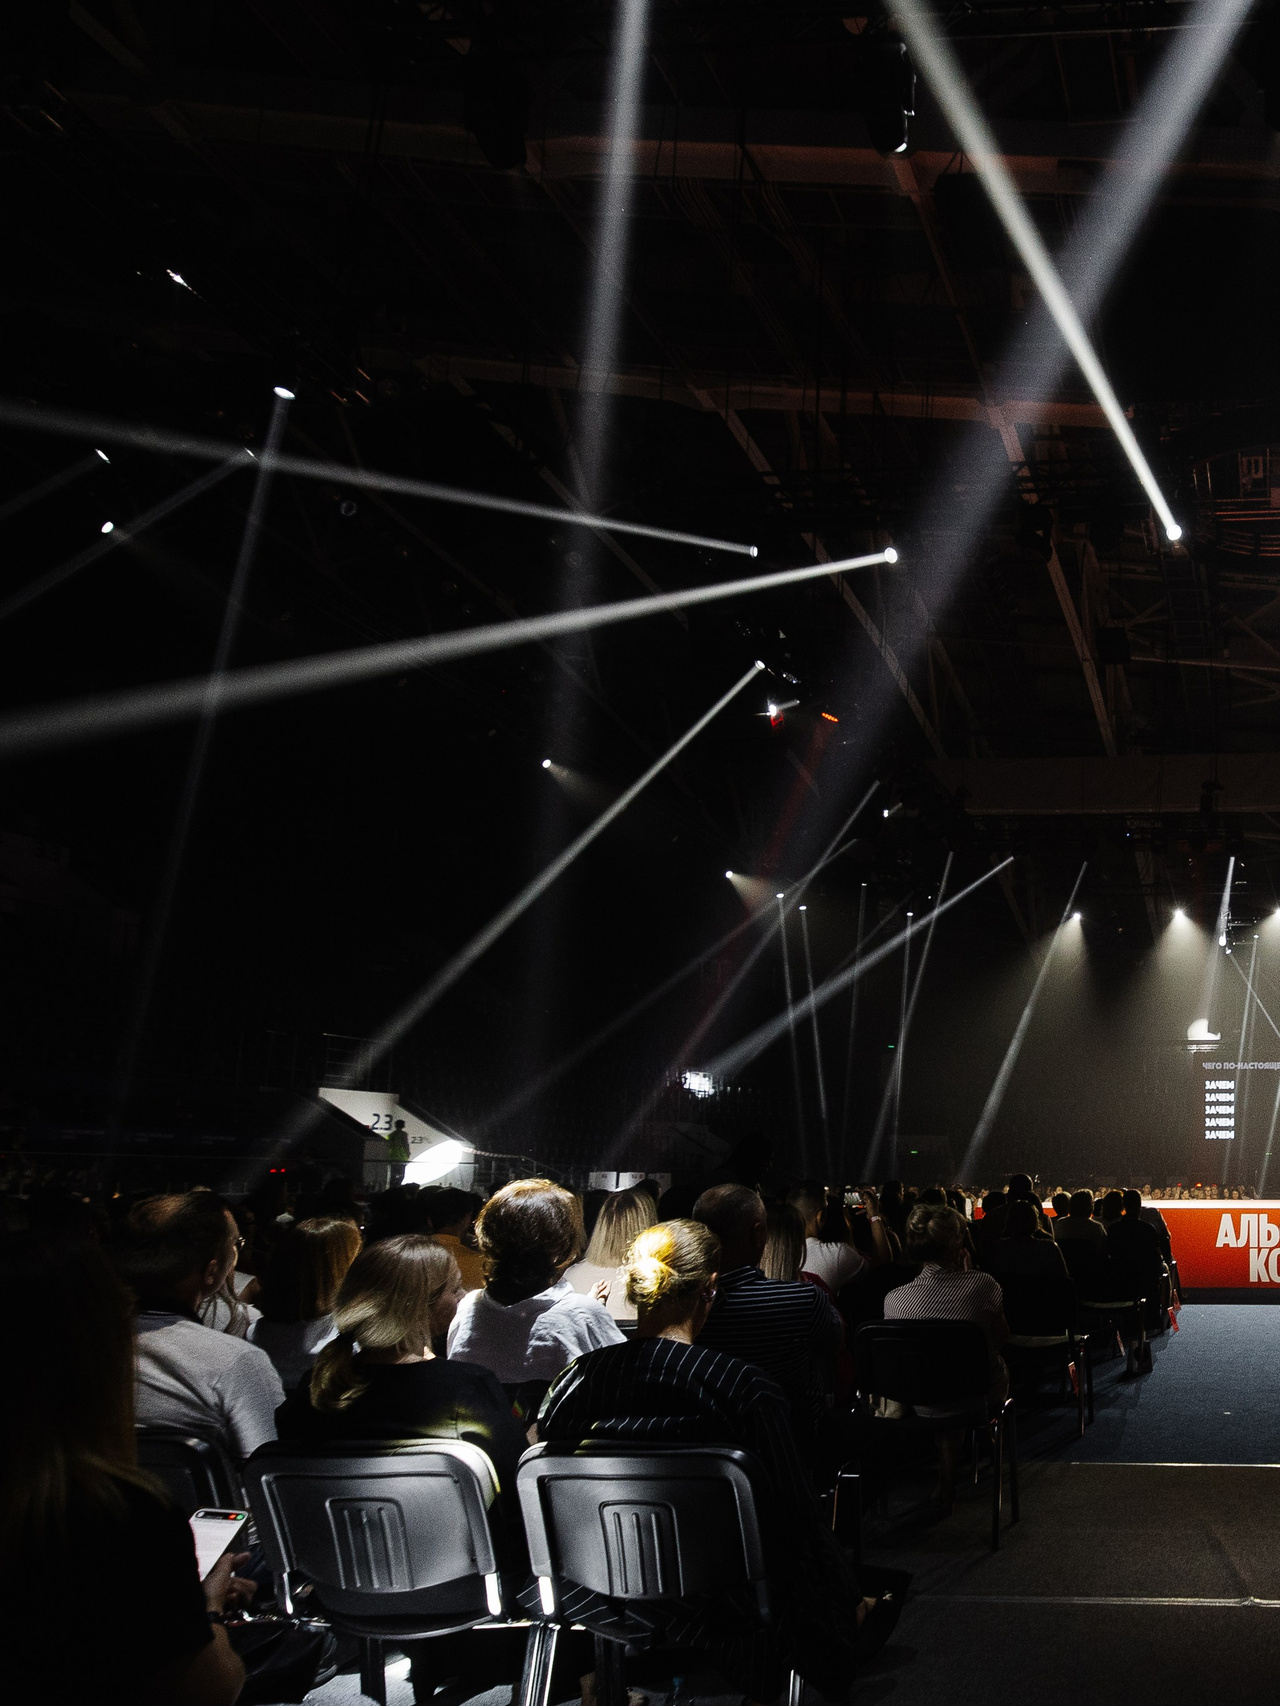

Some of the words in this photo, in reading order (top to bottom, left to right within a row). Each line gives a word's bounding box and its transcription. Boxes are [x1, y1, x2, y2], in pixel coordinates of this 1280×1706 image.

[1205, 1081, 1235, 1090] ЗАЧЕМ
[1205, 1093, 1235, 1102] ЗАЧЕМ
[1205, 1106, 1235, 1115] ЗАЧЕМ
[1205, 1118, 1235, 1127] ЗАЧЕМ
[1205, 1130, 1235, 1139] ЗАЧЕМ
